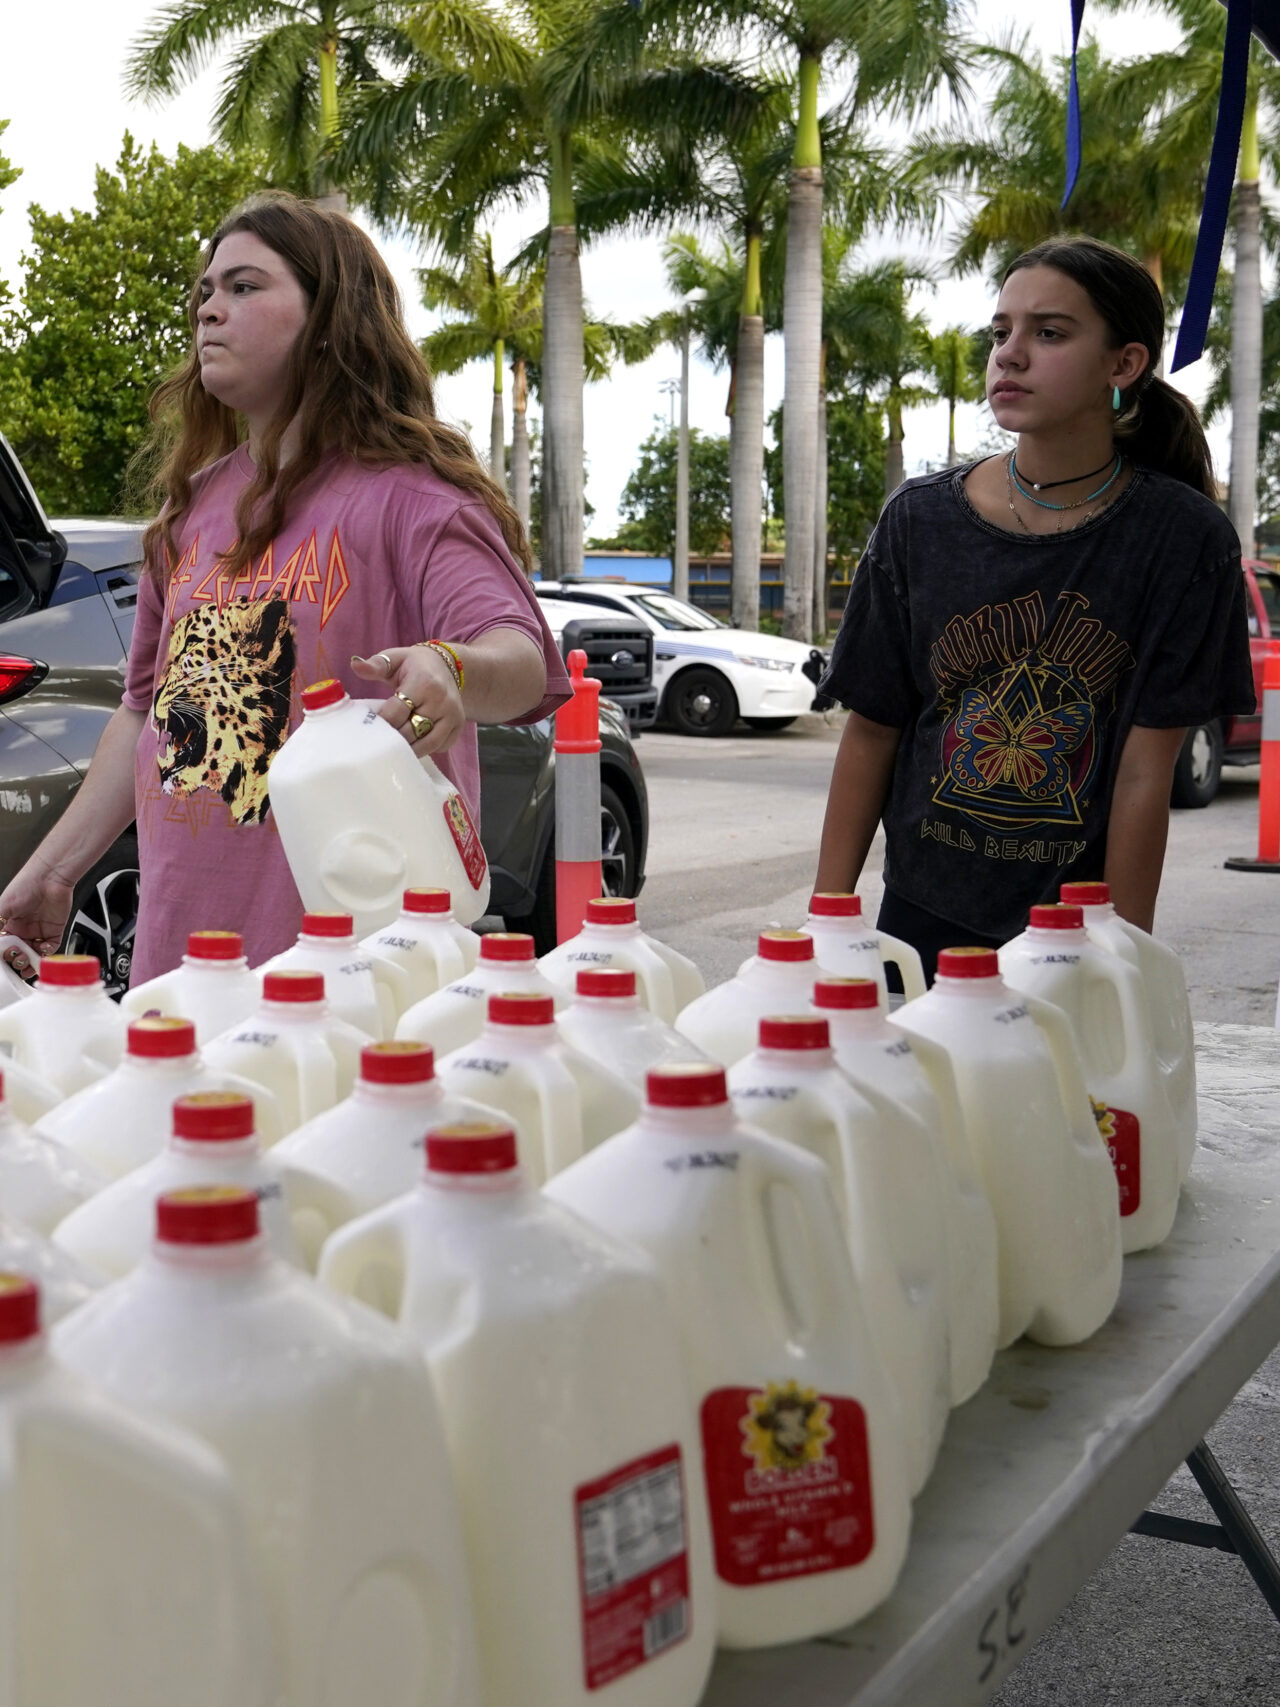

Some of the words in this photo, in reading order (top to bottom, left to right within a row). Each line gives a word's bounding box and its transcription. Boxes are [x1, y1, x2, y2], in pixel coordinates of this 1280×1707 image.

[929, 589, 1047, 689] WORLD
[921, 817, 976, 852] WILD
[984, 834, 1087, 867] BEAUTY
